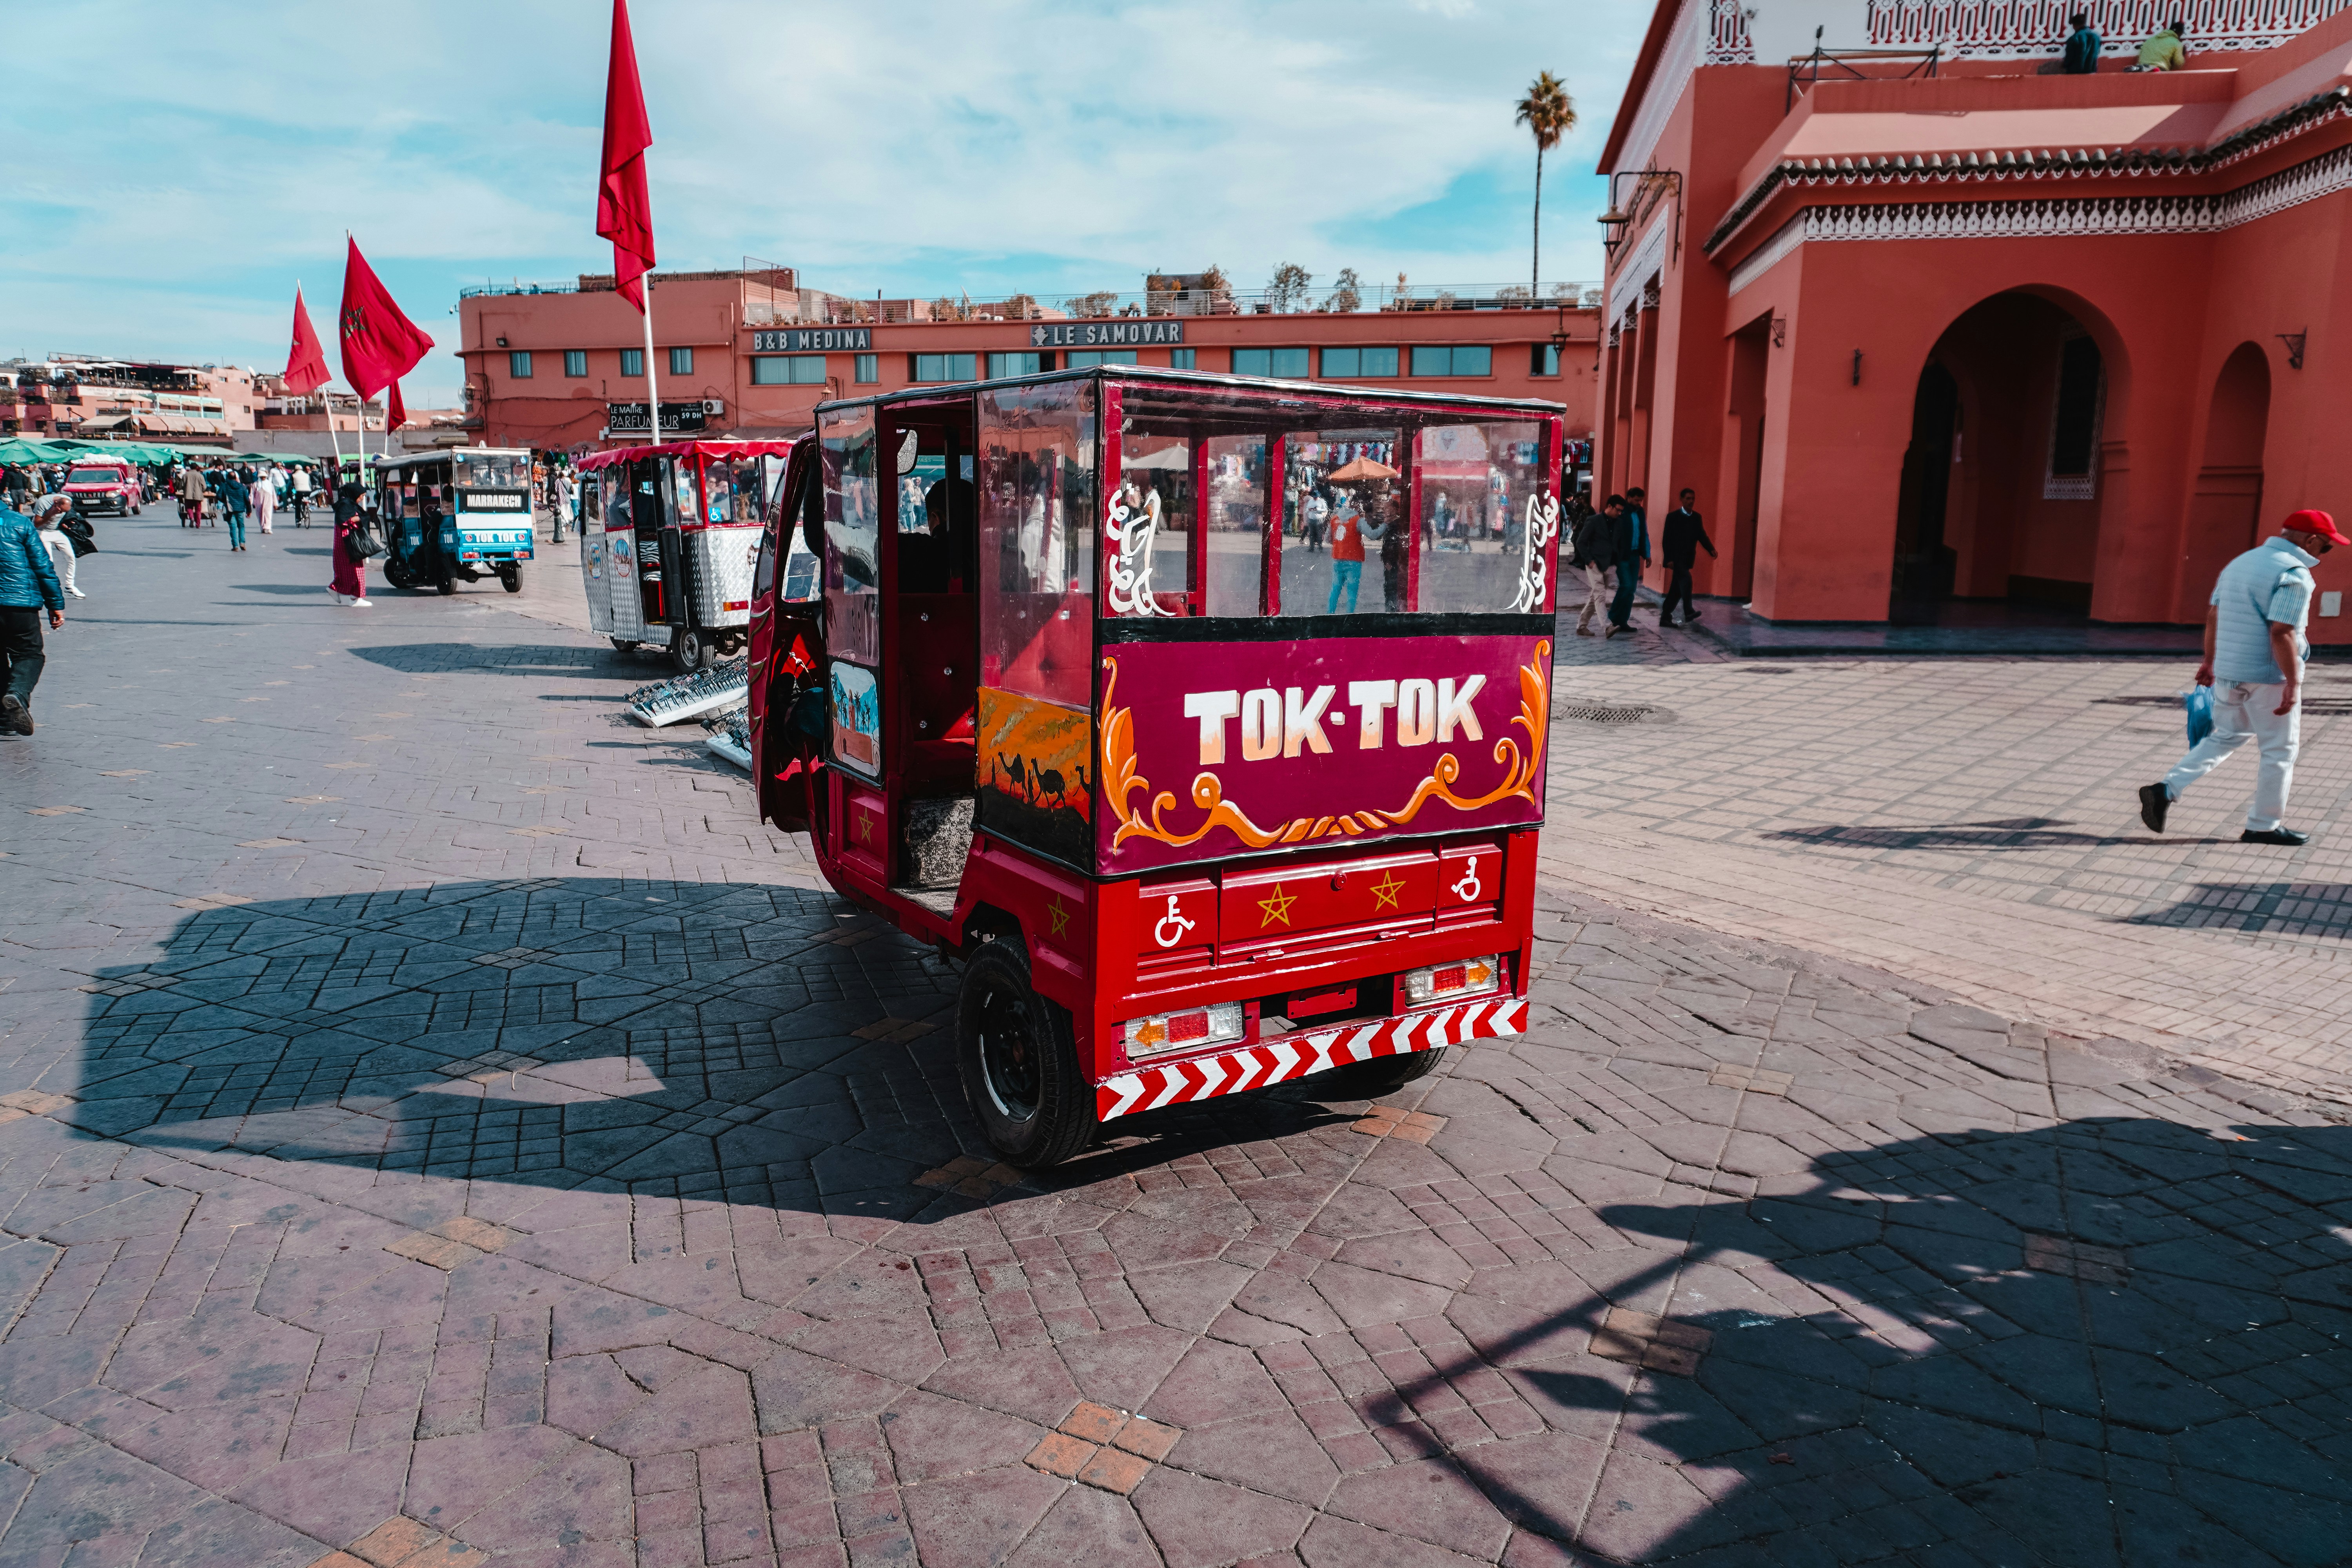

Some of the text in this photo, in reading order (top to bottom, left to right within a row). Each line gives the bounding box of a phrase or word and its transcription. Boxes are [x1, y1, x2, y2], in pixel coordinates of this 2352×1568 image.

[754, 330, 866, 350] B&B MEDINA
[1054, 324, 1180, 344] LE SAMOVAR
[466, 494, 521, 508] MARRAKECH
[410, 536, 420, 546] TOK
[444, 534, 453, 544] TOK
[474, 533, 516, 543] TOK TOK
